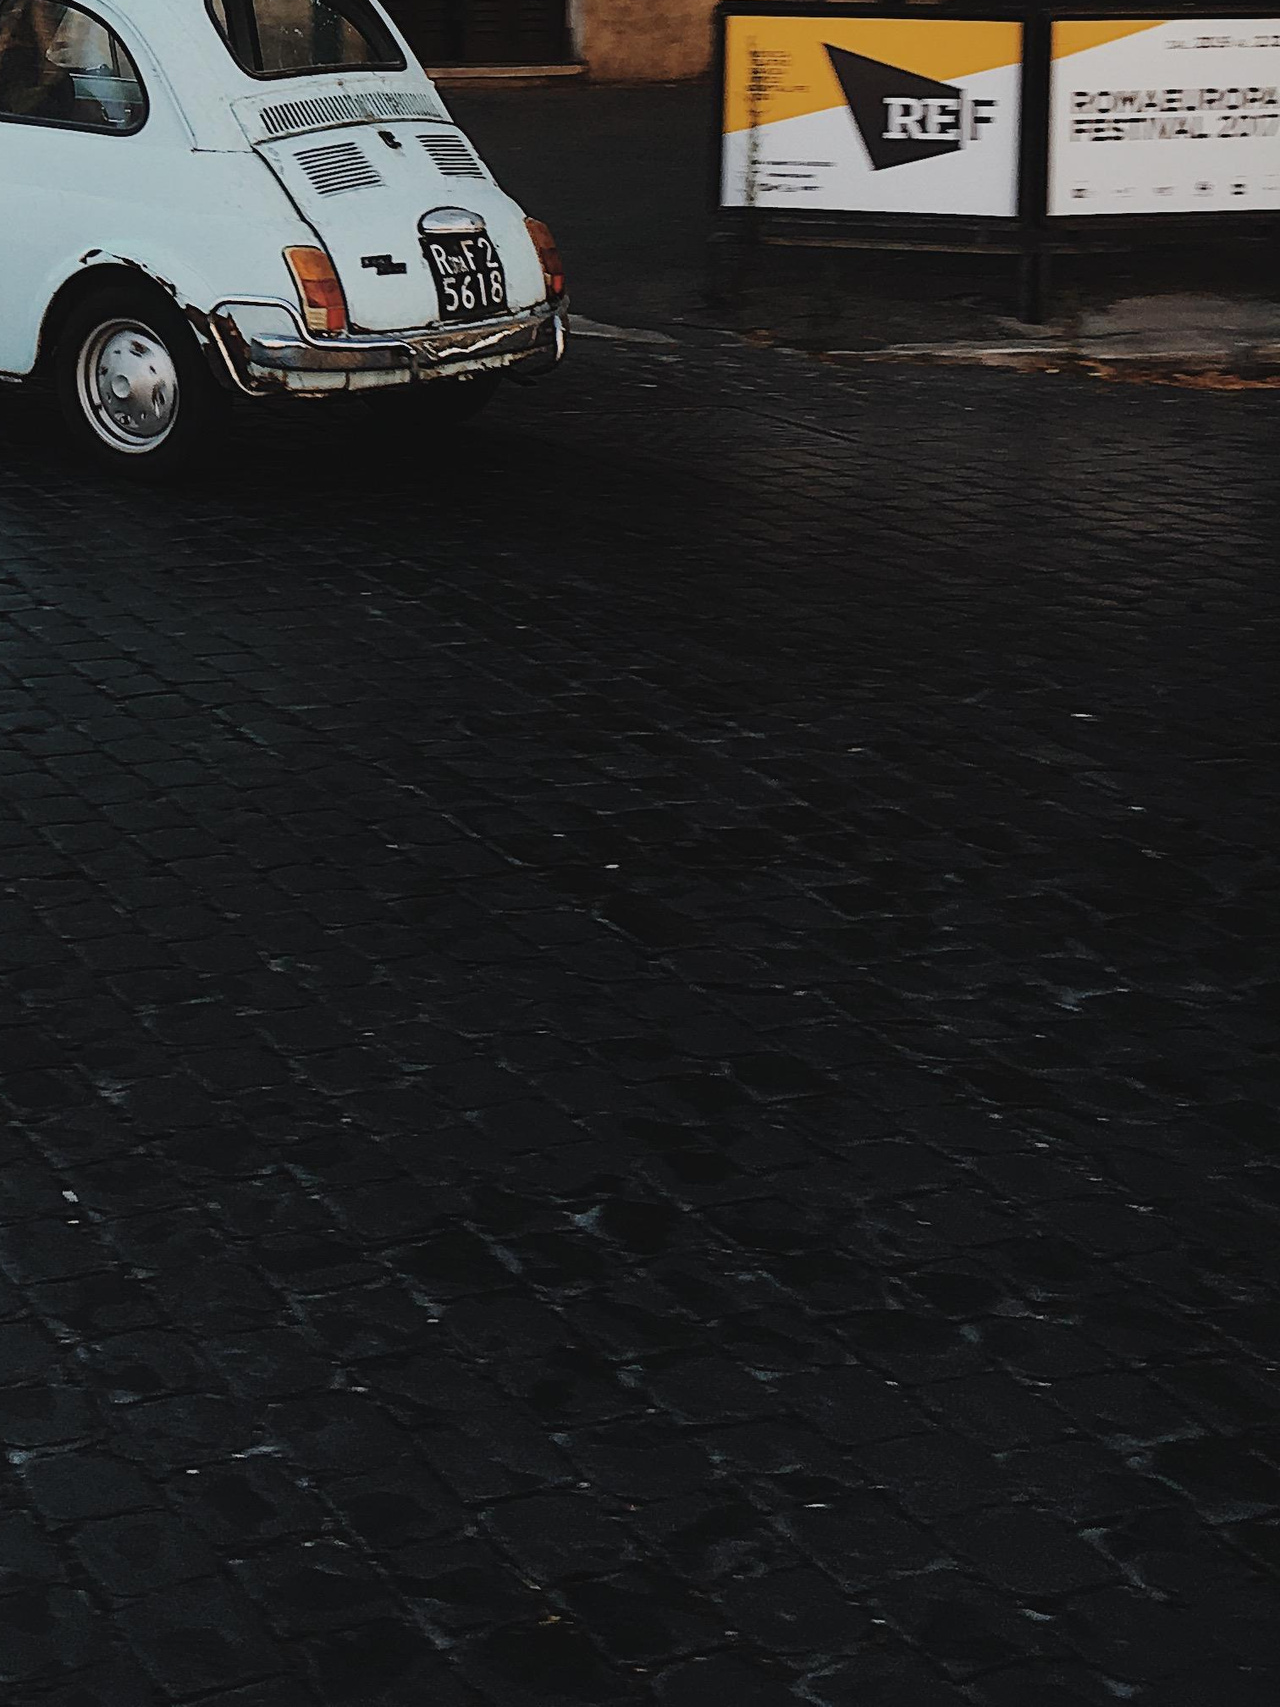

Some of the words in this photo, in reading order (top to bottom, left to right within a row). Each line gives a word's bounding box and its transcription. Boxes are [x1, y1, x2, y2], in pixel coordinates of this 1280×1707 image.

[882, 97, 998, 141] REF
[1071, 116, 1206, 142] FESTIVAL
[443, 270, 504, 311] 5618
